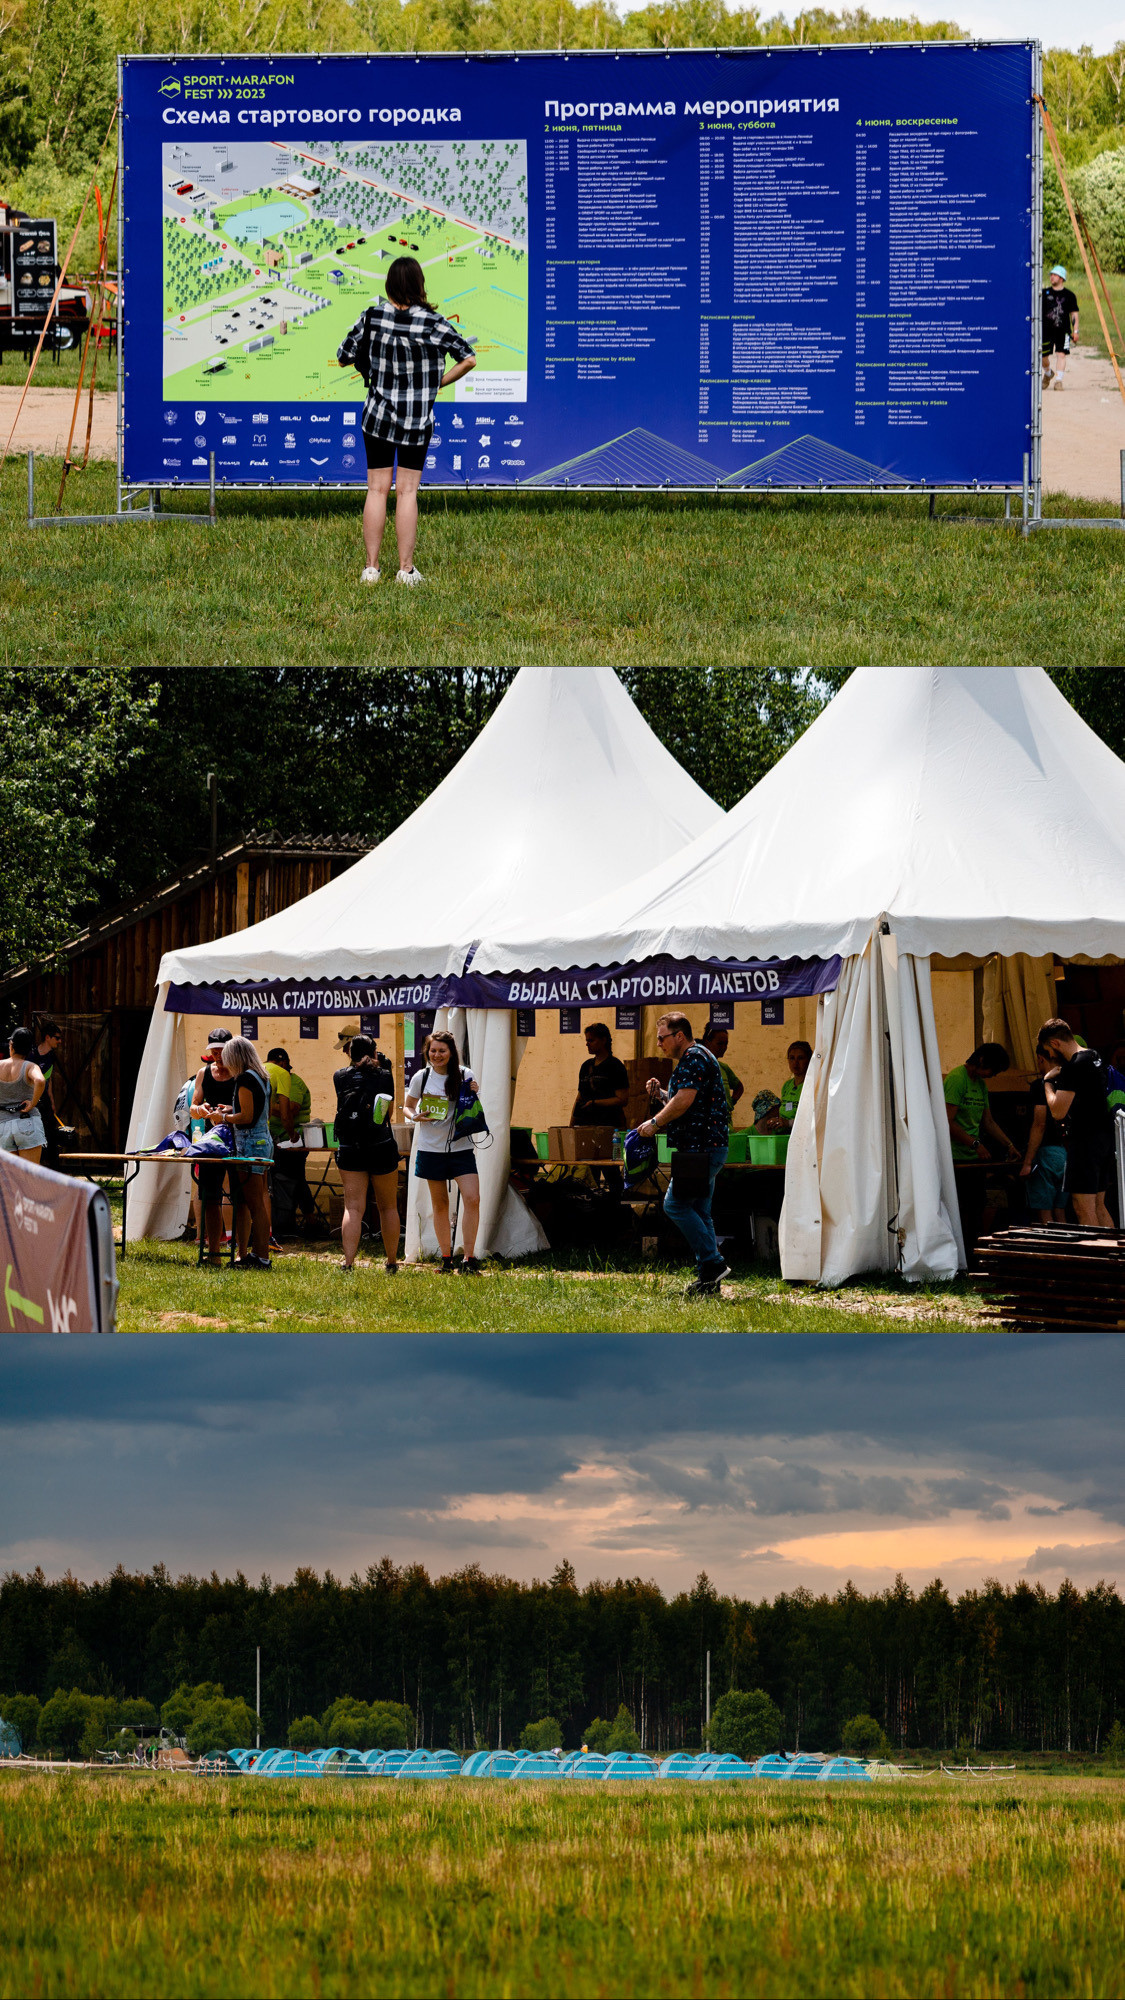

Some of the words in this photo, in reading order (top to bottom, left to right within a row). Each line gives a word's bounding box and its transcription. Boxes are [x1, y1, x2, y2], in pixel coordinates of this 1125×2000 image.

[185, 89, 214, 100] FEST
[235, 88, 266, 99] 2023
[162, 108, 230, 124] Схема
[238, 108, 362, 126] стартового
[369, 106, 462, 126] городка
[545, 100, 676, 121] Программа
[684, 98, 840, 118] мероприятия
[544, 124, 550, 132] 2
[896, 117, 958, 126] воскресенье
[508, 982, 582, 1004] ВЫДАЧА
[587, 974, 692, 1001] СТАРТОВЫХ
[698, 970, 779, 994] ПАКЕТОВ
[221, 991, 278, 1012] ВЫДАЧА
[283, 989, 364, 1010] СТАРТОВЫХ
[368, 984, 431, 1007] ПАКЕТОВ
[426, 1105, 446, 1115] 1012
